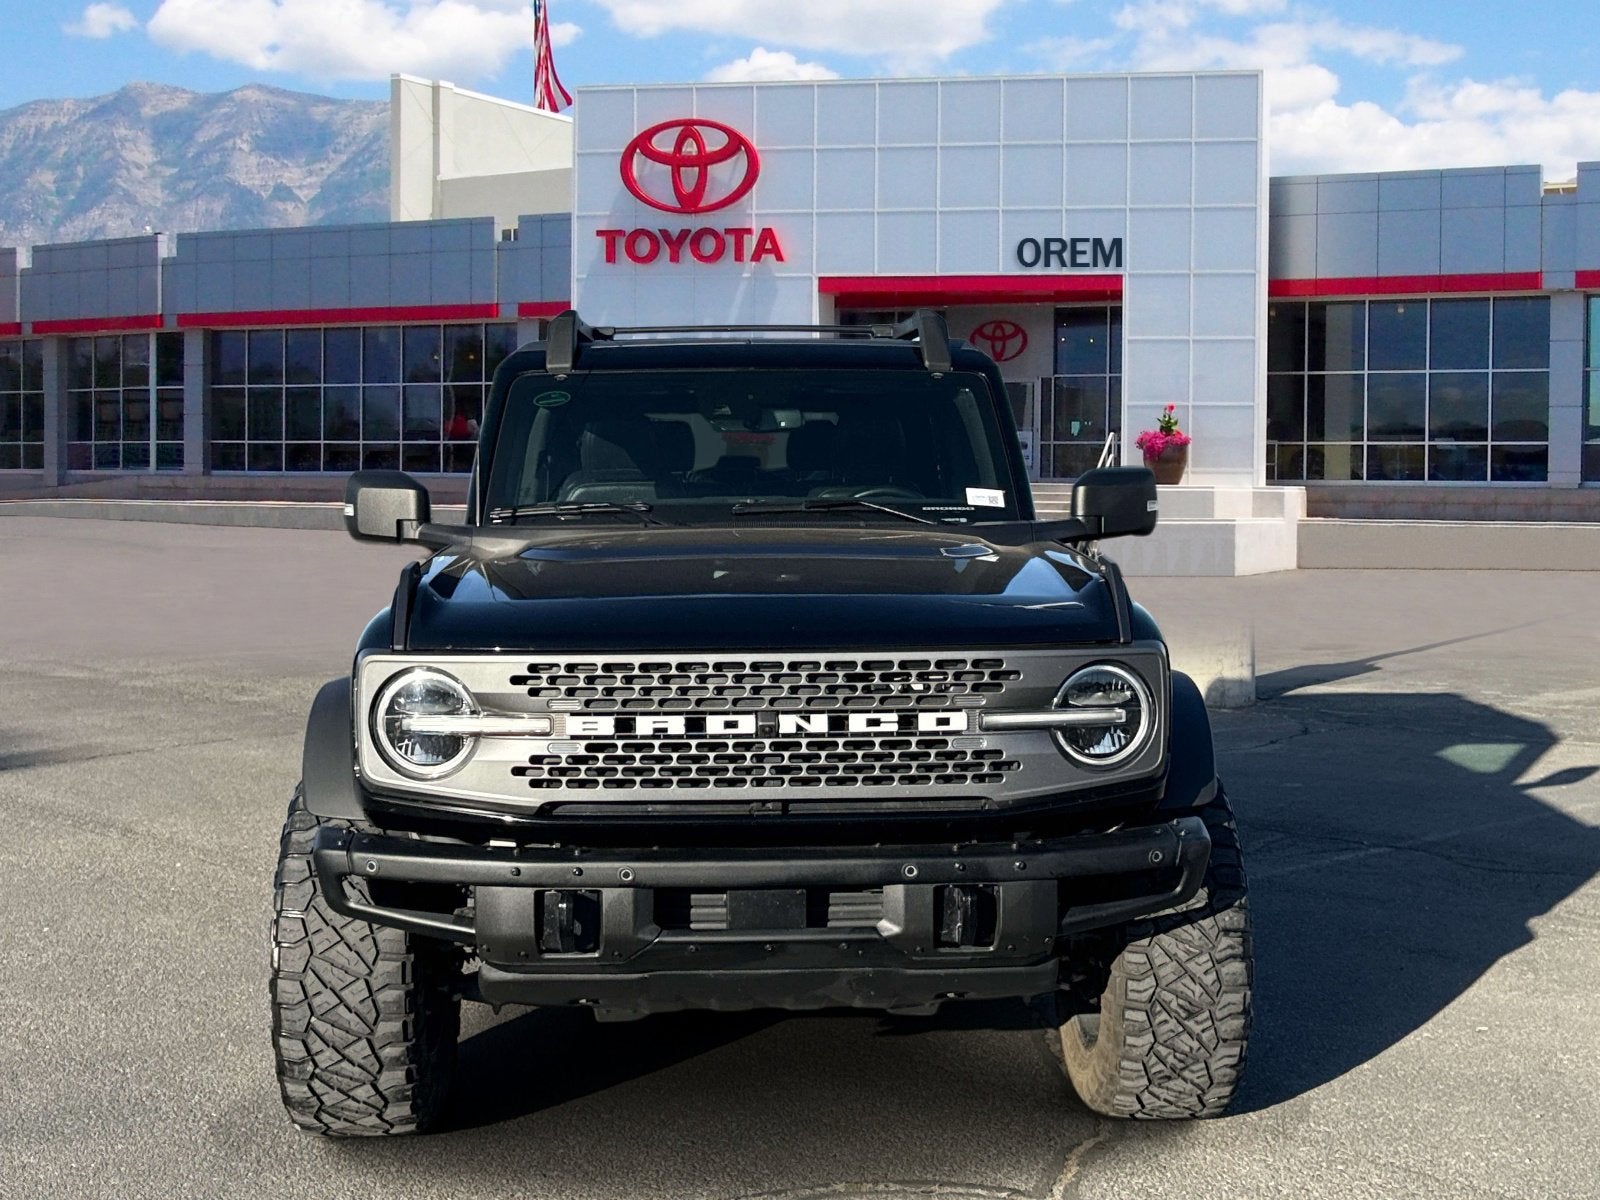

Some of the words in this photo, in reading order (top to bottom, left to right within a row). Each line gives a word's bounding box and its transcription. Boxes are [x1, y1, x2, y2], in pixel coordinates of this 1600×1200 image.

[596, 227, 785, 264] TOYOTA
[1017, 237, 1123, 268] OREM
[565, 711, 968, 736] BRONCO
